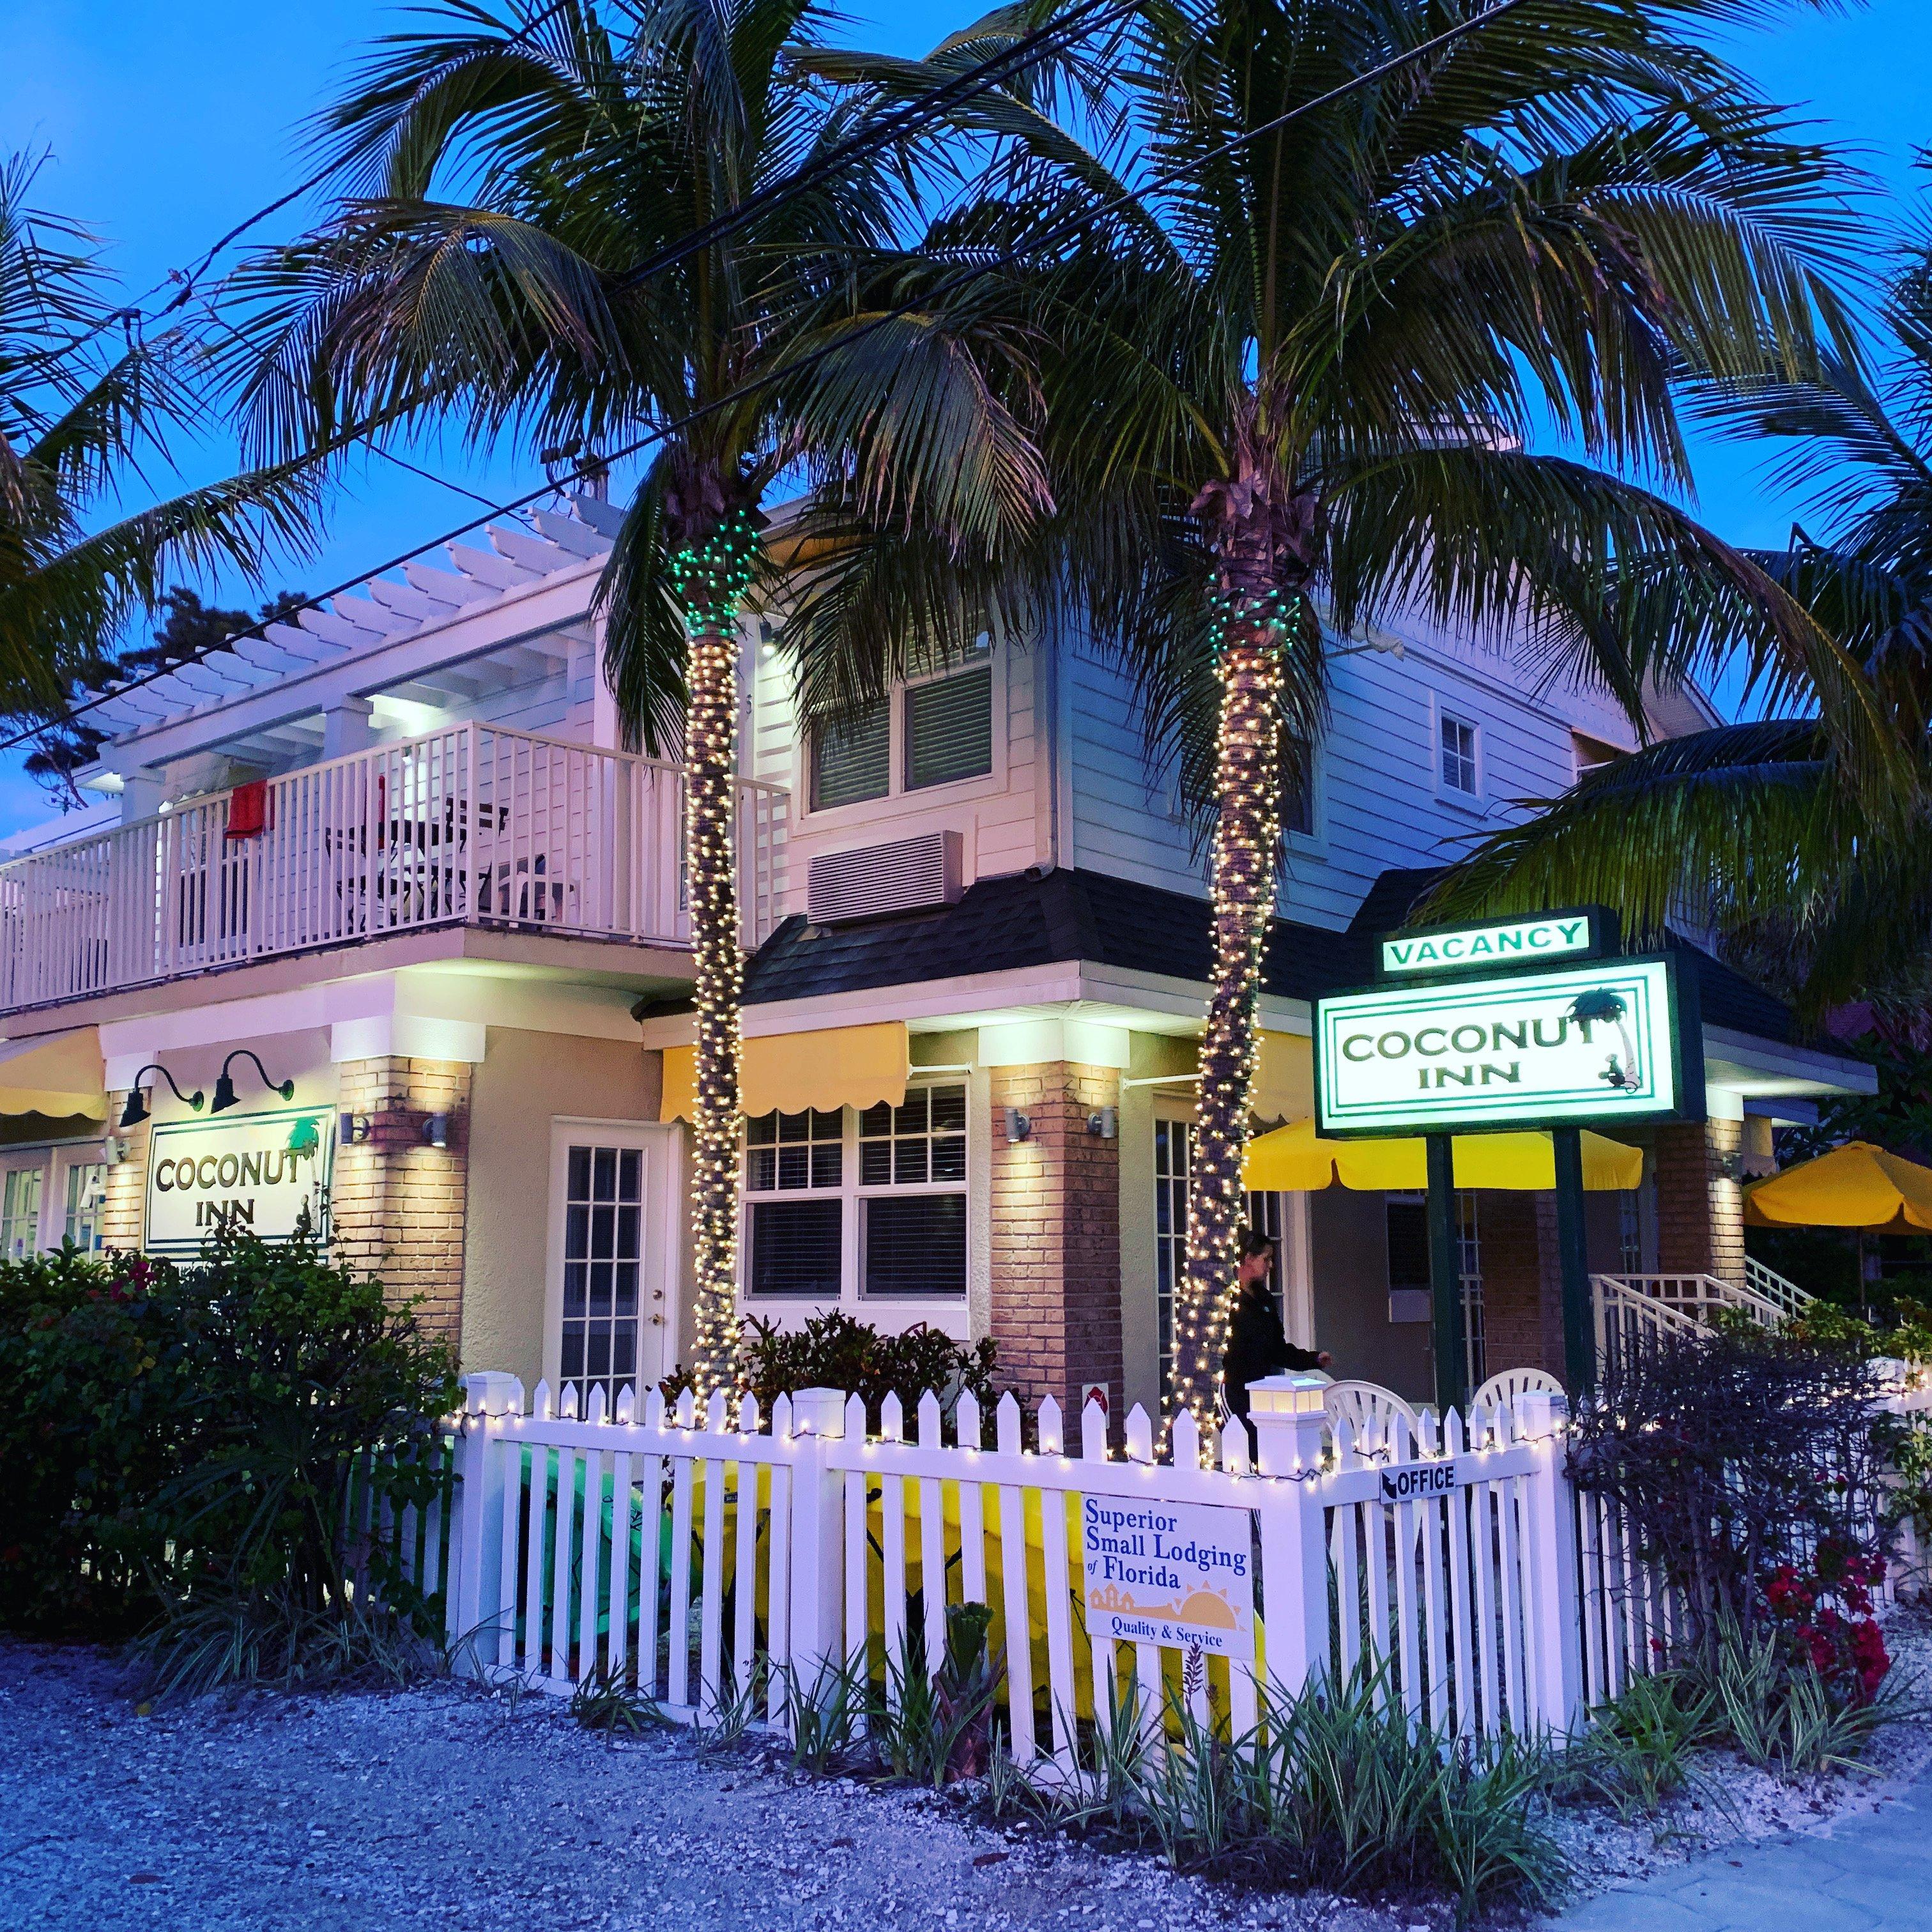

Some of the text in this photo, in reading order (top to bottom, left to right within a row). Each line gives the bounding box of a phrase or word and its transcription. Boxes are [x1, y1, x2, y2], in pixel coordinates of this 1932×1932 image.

[1390, 922, 1583, 965] VACANCY
[1342, 1016, 1597, 1062] COCONUT
[1418, 1061, 1521, 1089] INN
[156, 1149, 303, 1192] COCONUT
[195, 1199, 255, 1226] INN
[1397, 1466, 1454, 1495] OFFICE
[1085, 1498, 1177, 1533] Superior
[1087, 1526, 1246, 1576] Small Lodging
[1087, 1555, 1181, 1590] of Florida
[1111, 1616, 1223, 1647] Quality & Service
